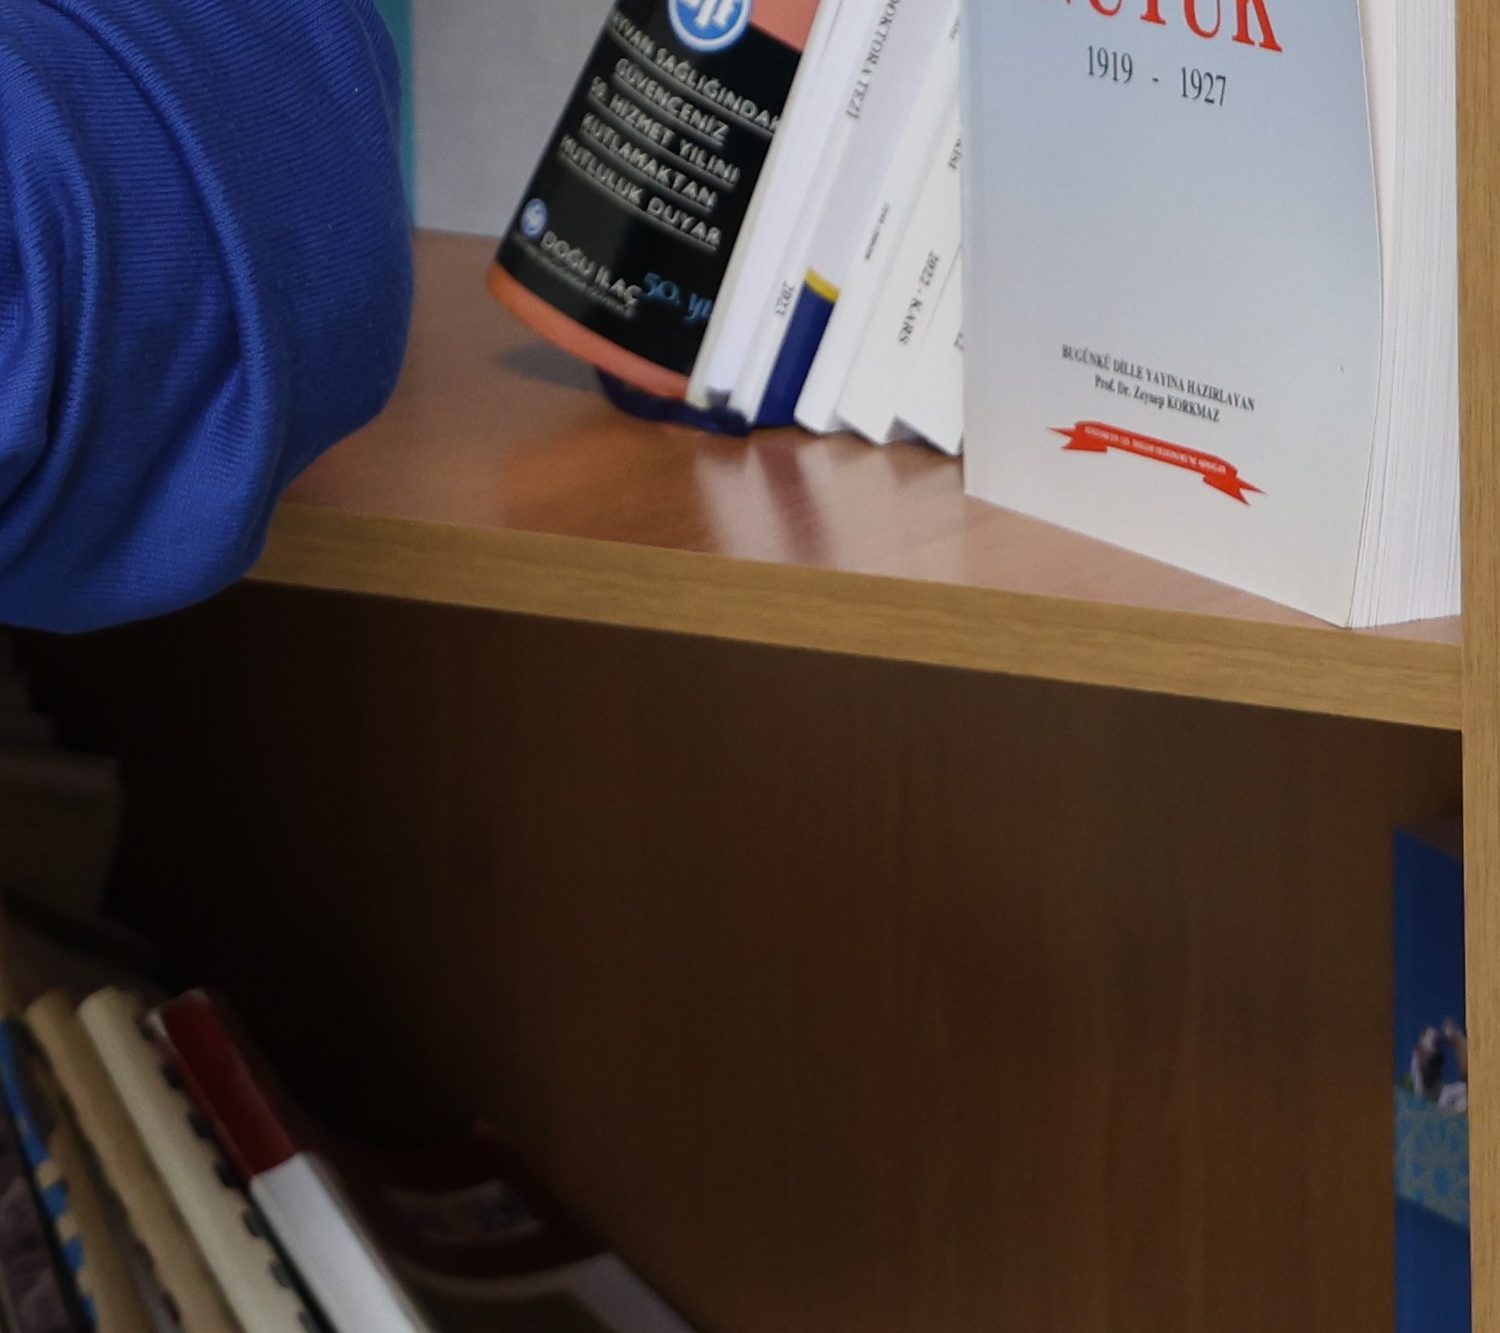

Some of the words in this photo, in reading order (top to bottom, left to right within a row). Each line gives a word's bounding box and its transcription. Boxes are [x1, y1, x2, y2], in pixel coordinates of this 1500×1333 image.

[1086, 44, 1134, 84] 1919
[1180, 65, 1227, 107] 1927
[646, 196, 723, 248] DUYAR
[1061, 343, 1111, 371] BUGÜNKÜ
[1113, 355, 1144, 380] DİLLE
[1145, 367, 1186, 394] YAYINA
[1187, 378, 1256, 412] HAZIRLAYAN
[1117, 378, 1132, 397] Dr.
[1133, 384, 1166, 411] Zeynep
[1166, 394, 1221, 424] KORKMAZ
